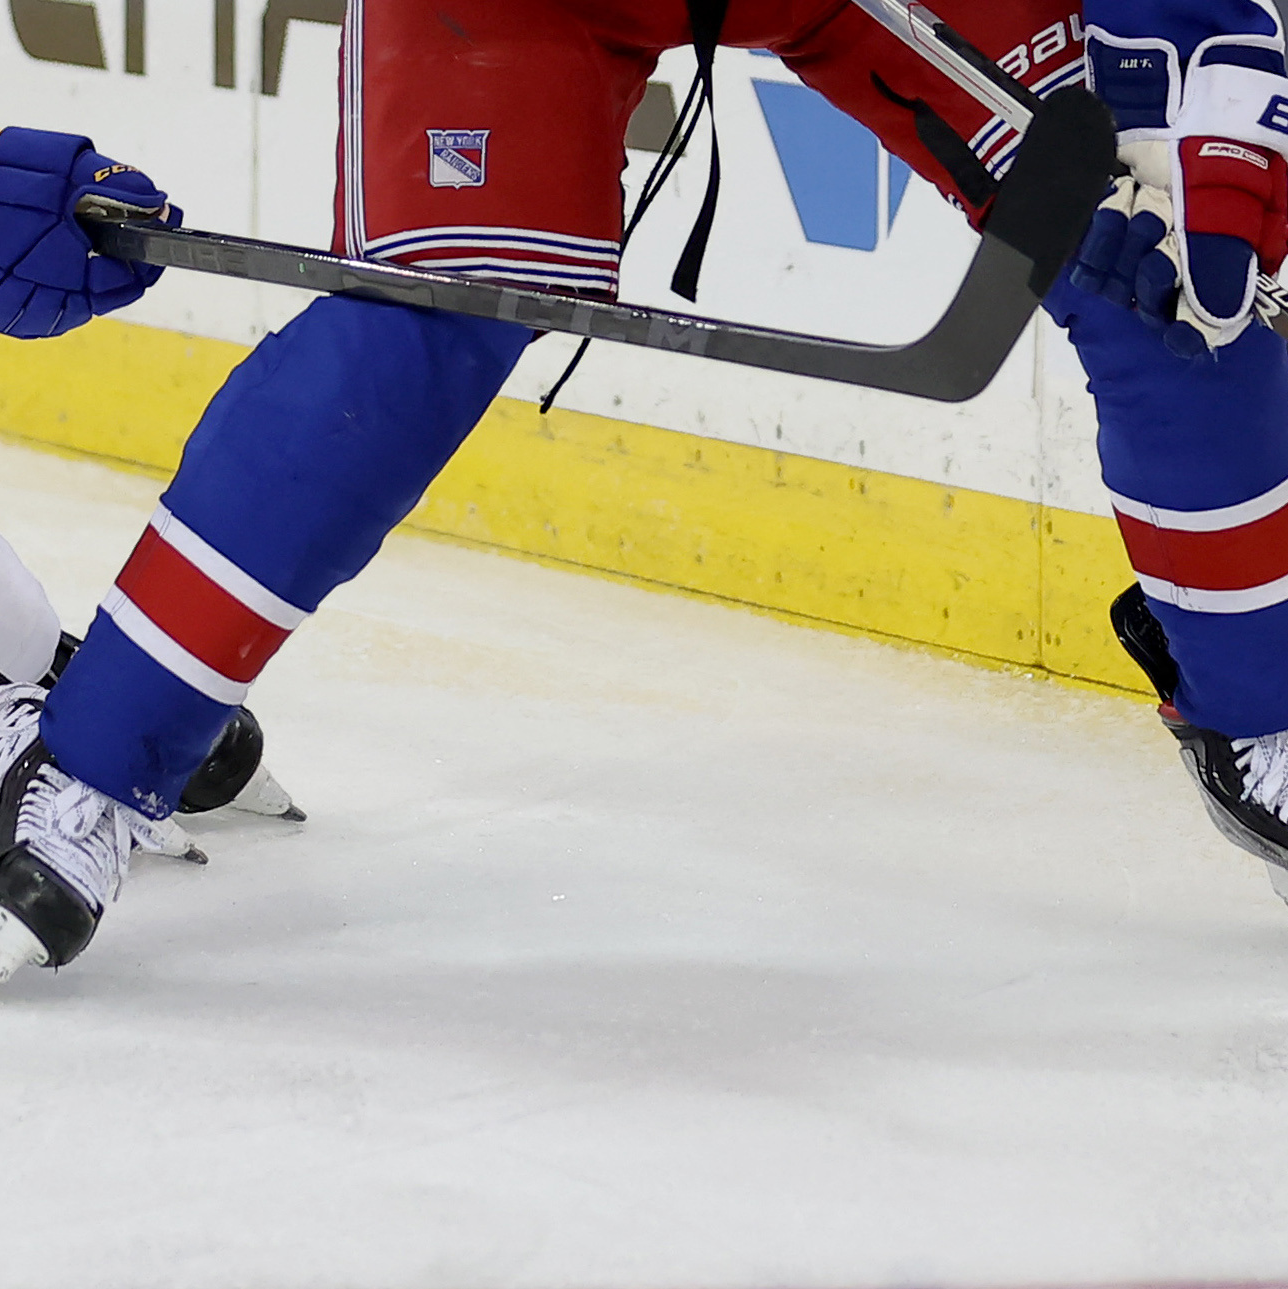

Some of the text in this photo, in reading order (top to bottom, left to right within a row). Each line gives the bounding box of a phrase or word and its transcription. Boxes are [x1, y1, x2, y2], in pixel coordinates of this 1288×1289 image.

[433, 135, 482, 146] NEW YORK
[1207, 145, 1242, 155] PRO
[439, 148, 481, 181] RANGERS
